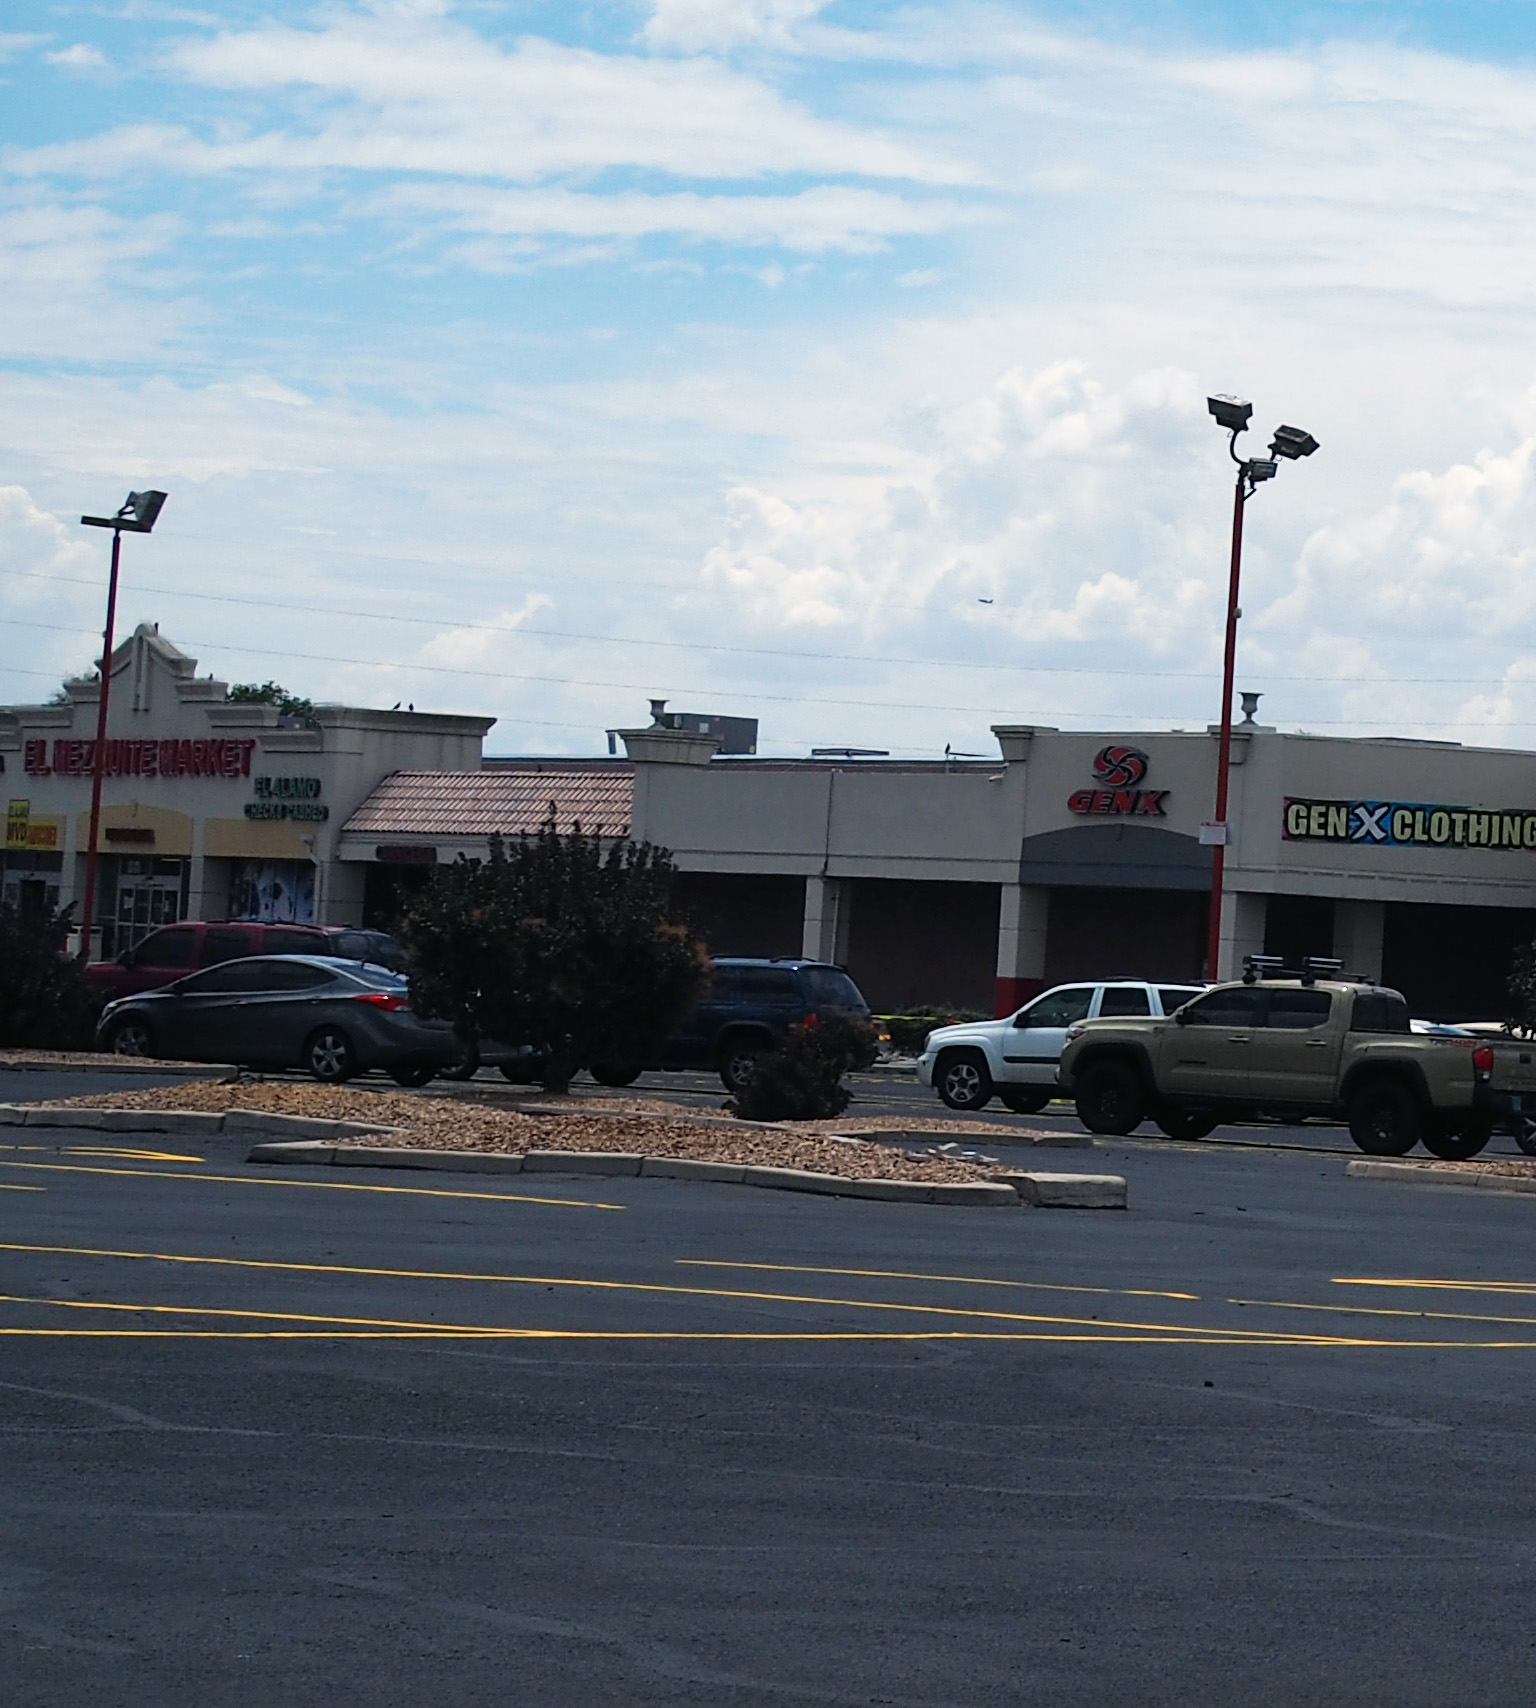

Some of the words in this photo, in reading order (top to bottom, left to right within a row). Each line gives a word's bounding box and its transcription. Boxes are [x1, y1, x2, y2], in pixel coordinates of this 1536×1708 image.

[25, 738, 50, 776] EL
[159, 738, 256, 779] MARKET
[1067, 789, 1171, 816] GENX
[1287, 803, 1348, 838] GEN
[1352, 803, 1389, 840] X
